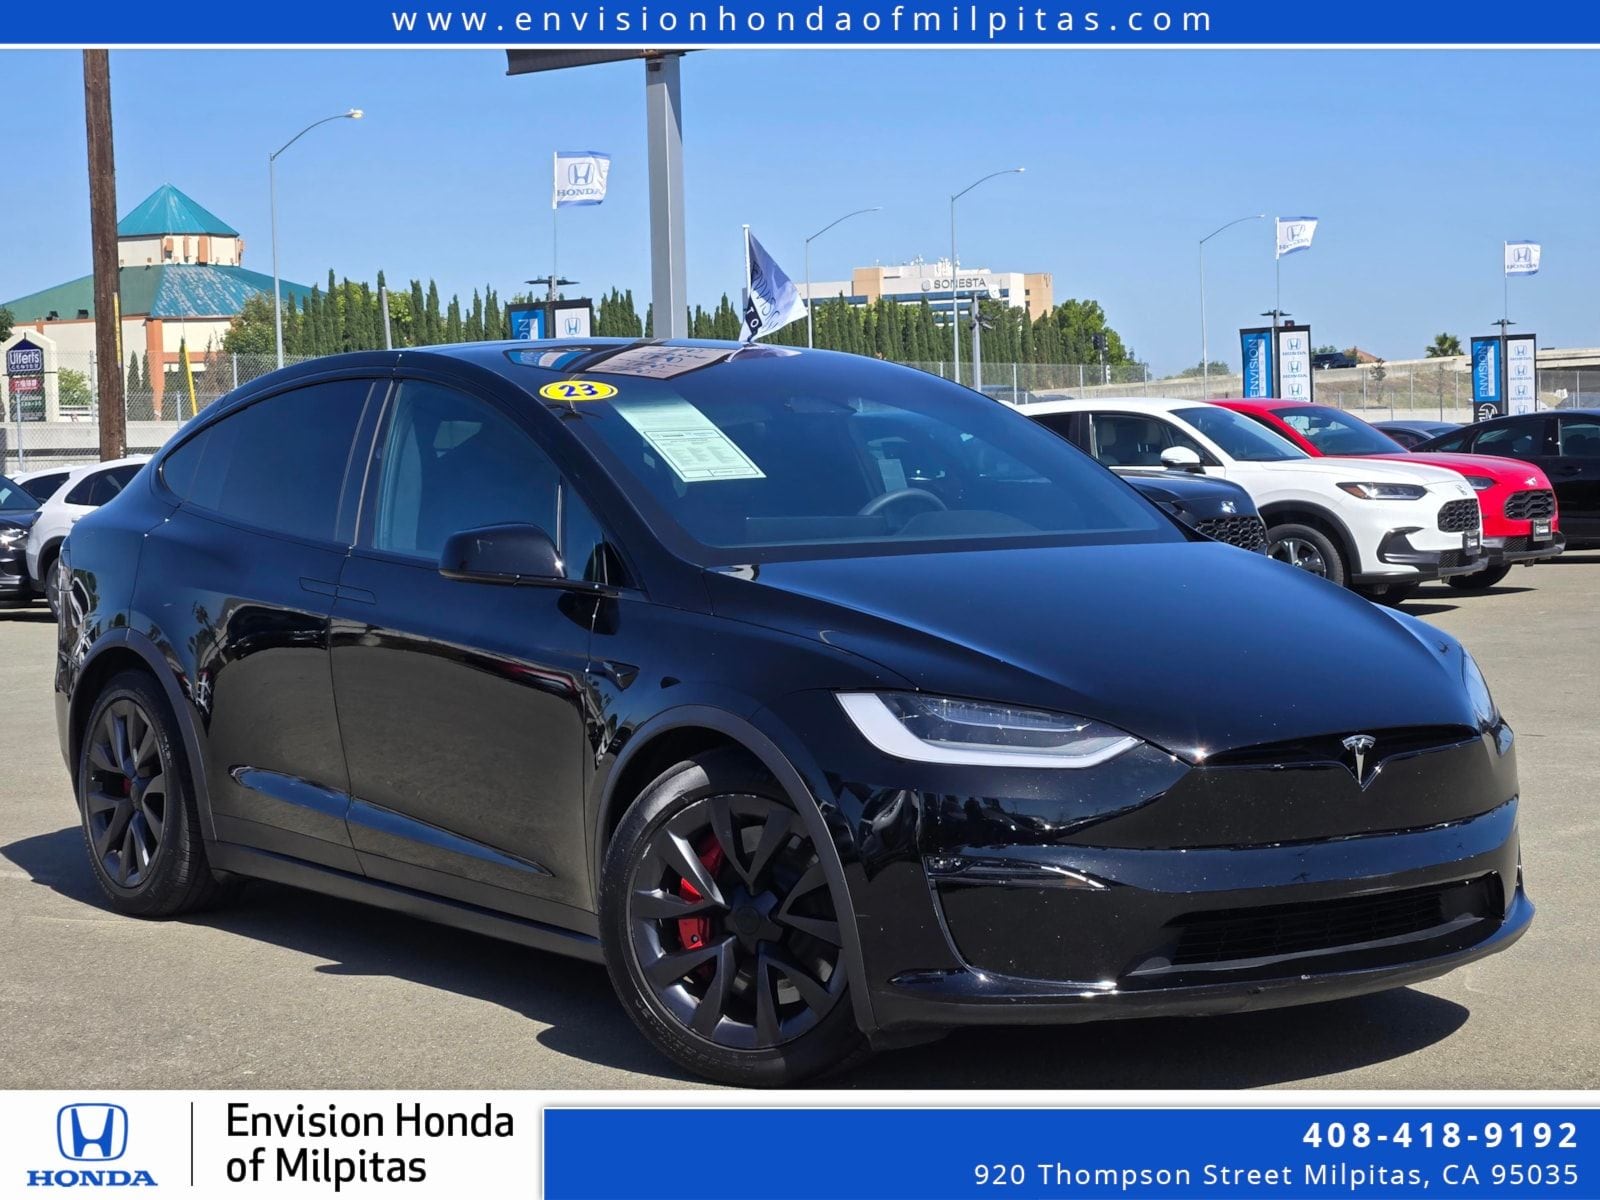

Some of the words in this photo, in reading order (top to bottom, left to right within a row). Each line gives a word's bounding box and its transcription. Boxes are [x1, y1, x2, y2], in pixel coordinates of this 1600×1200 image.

[557, 188, 603, 197] HONDA
[933, 278, 987, 289] SONESTA
[1248, 339, 1260, 398] ENVISION
[1478, 345, 1489, 397] ENVISION
[558, 383, 599, 398] 23
